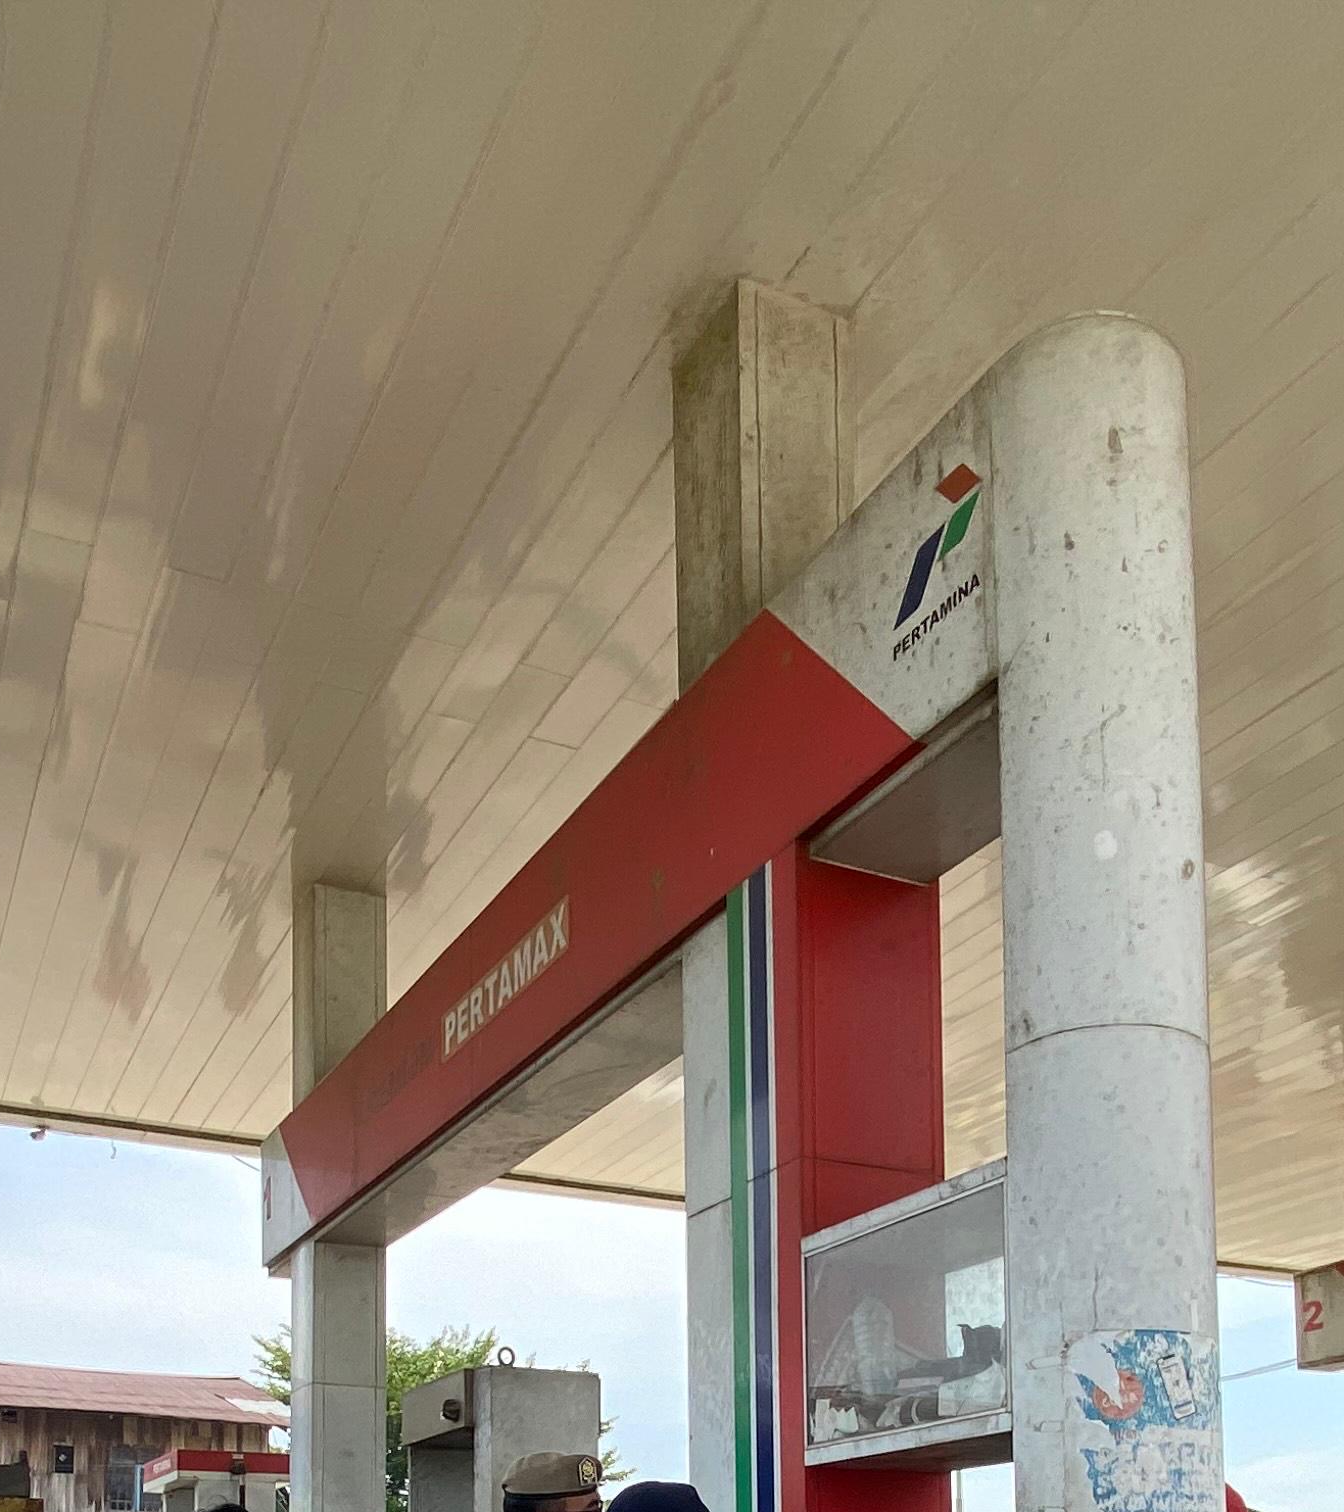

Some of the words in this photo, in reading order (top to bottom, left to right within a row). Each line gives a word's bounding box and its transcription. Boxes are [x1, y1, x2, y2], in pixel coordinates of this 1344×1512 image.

[893, 573, 981, 661] PERTAMINA
[443, 902, 568, 1057] PERTAMAX
[1302, 1300, 1324, 1333] 2
